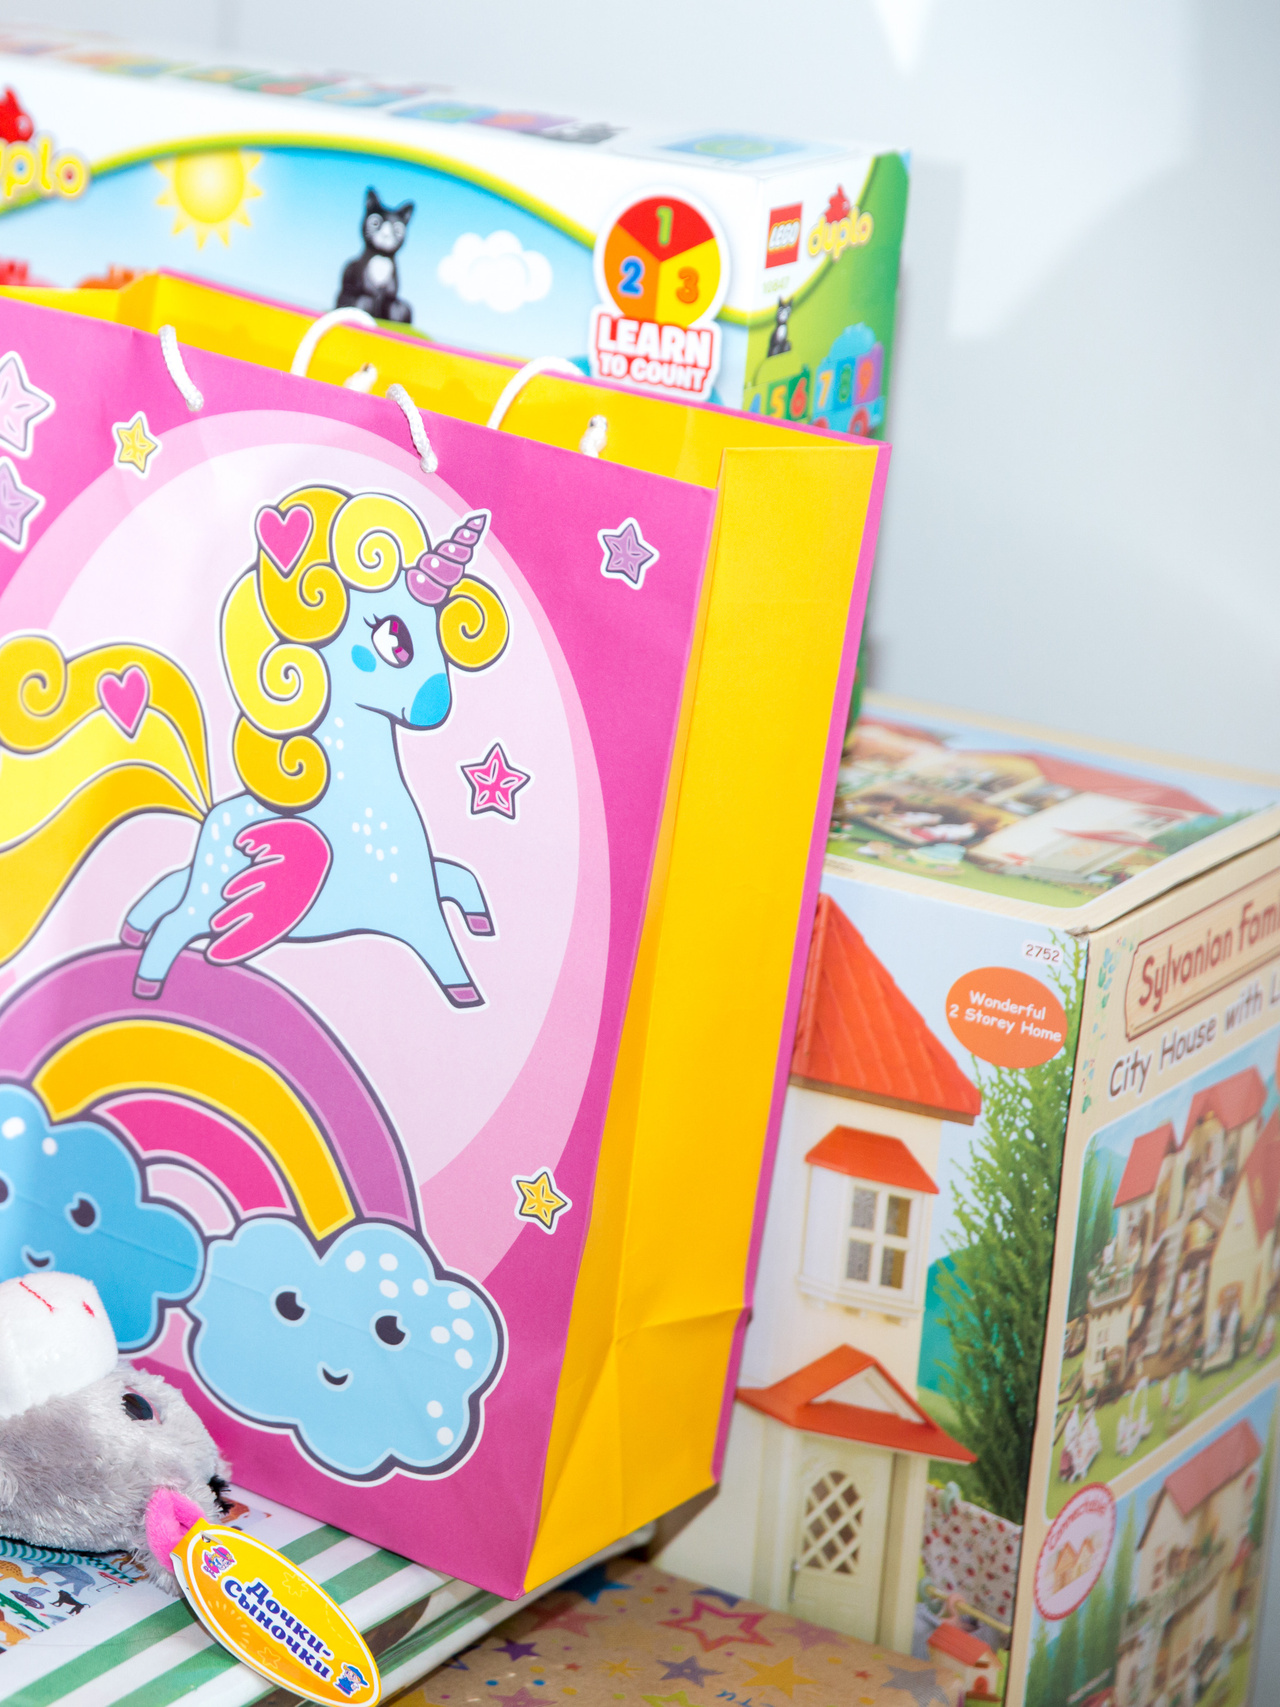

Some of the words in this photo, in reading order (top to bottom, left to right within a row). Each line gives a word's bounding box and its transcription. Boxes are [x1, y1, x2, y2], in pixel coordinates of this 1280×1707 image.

[656, 206, 673, 246] 1
[769, 219, 800, 249] LEGO
[807, 206, 874, 262] duplo
[619, 257, 644, 296] 2
[675, 266, 700, 305] 3
[599, 314, 712, 367] LEARN
[600, 353, 623, 378] TO
[629, 359, 708, 392] COUNT
[1025, 943, 1061, 963] 2752
[1138, 928, 1233, 1013] Sylvanian
[949, 1003, 959, 1018] 2
[964, 1008, 1015, 1034] Storey
[1021, 1021, 1062, 1043] Home
[970, 990, 1046, 1021] Wonderful
[1109, 1048, 1152, 1098] City
[1160, 1017, 1216, 1071] House
[1225, 977, 1263, 1032] with
[224, 1579, 331, 1679] Сыночки
[246, 1581, 332, 1657] Дочки-
